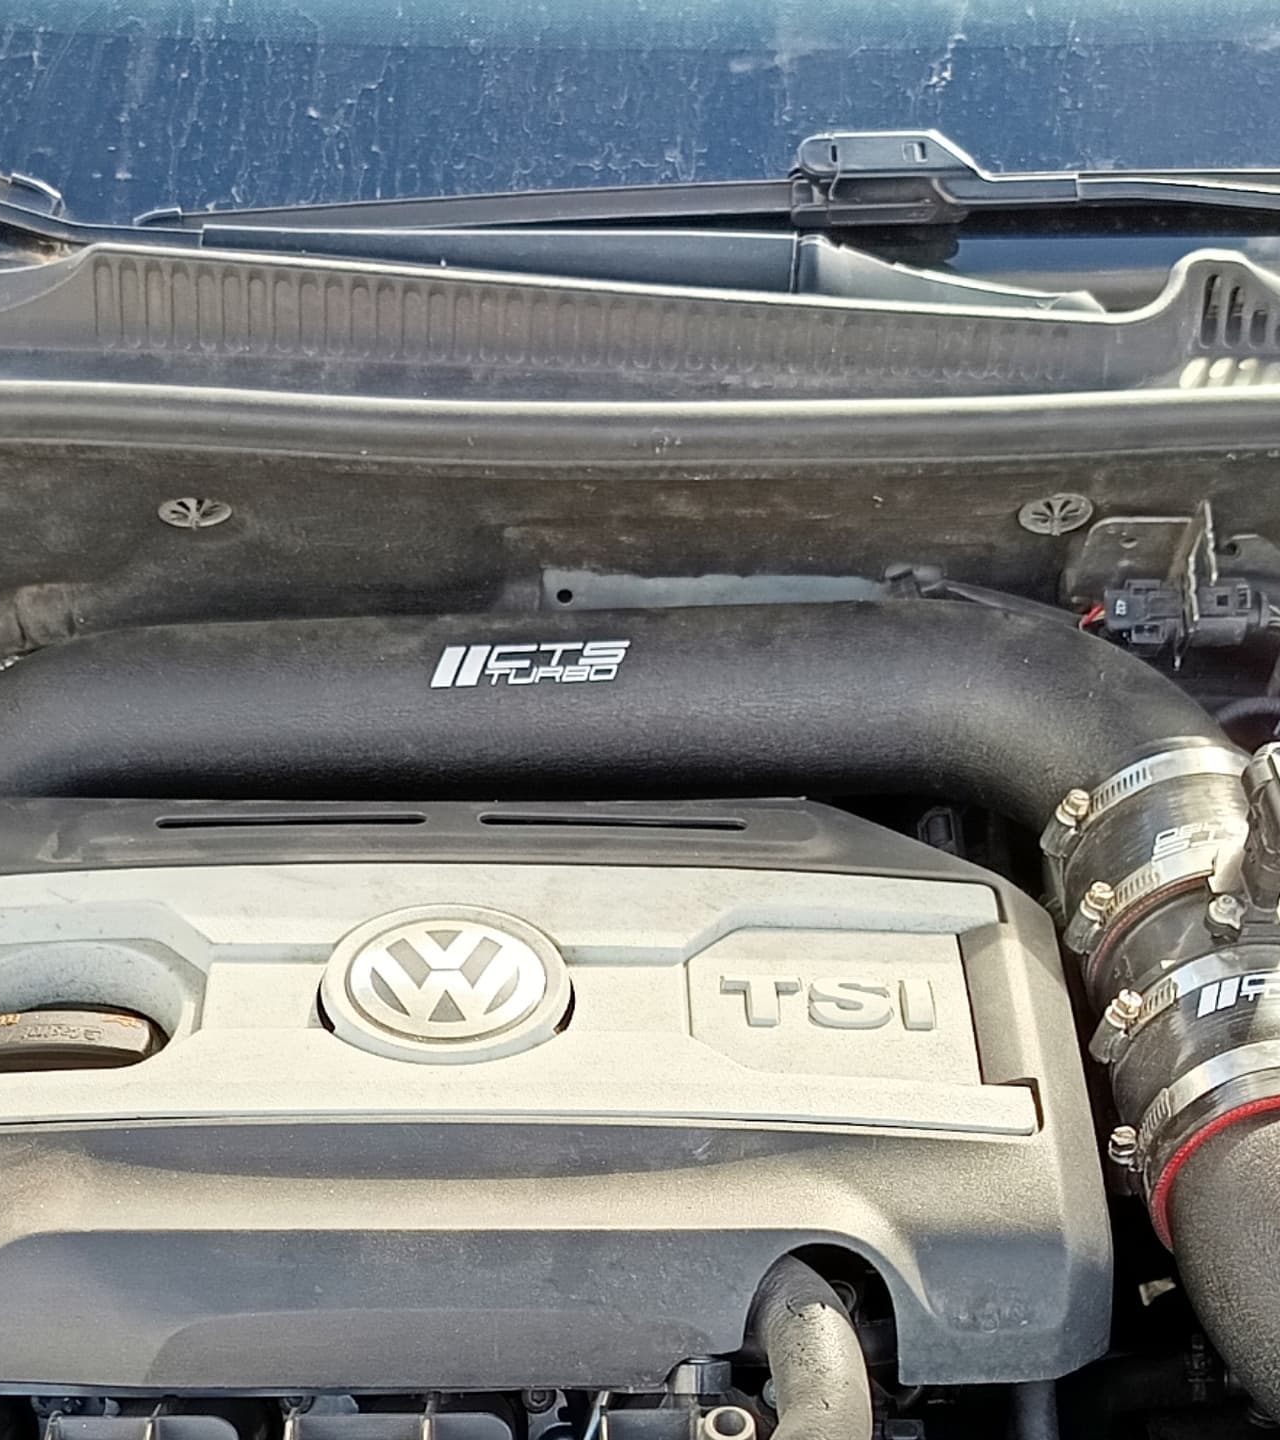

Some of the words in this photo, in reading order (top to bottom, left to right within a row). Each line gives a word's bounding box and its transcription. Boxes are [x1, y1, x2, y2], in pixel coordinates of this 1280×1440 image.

[487, 640, 630, 668] CTS
[485, 664, 617, 686] TURBO
[720, 974, 937, 1031] TSI
